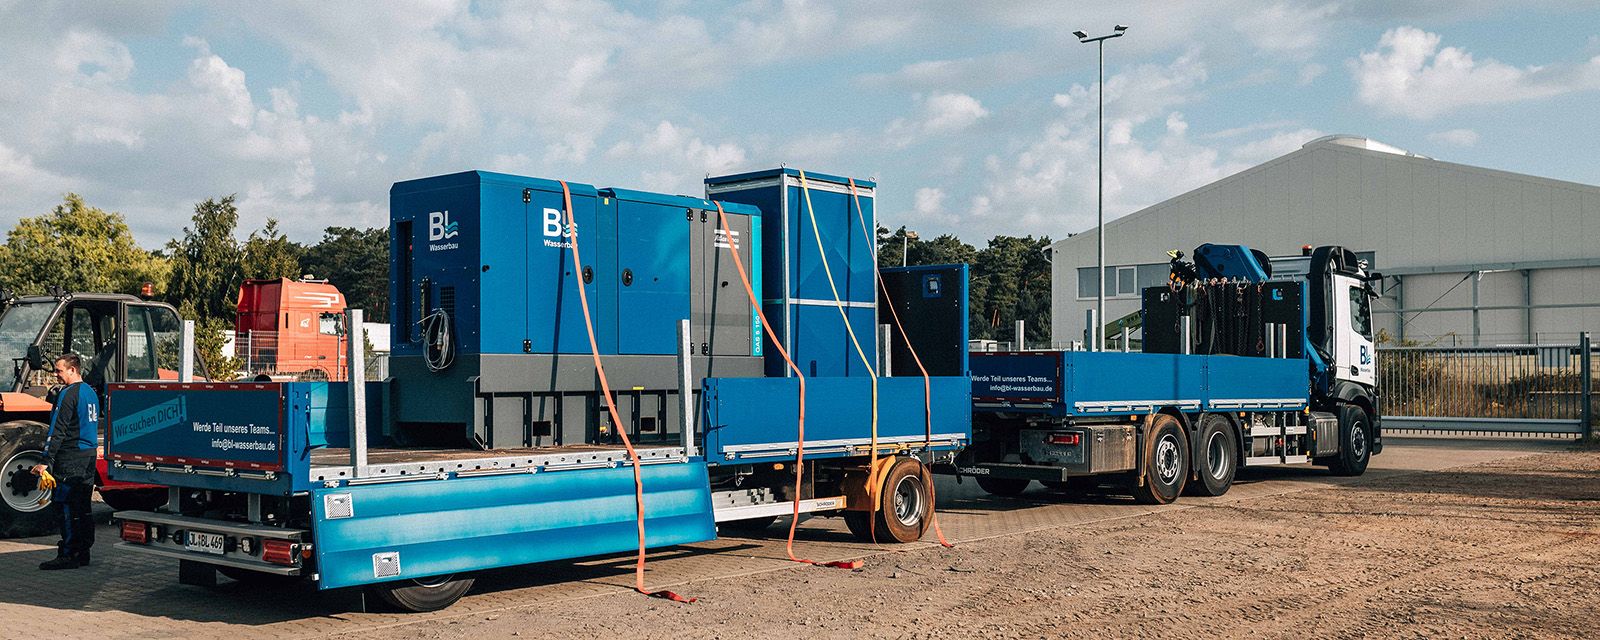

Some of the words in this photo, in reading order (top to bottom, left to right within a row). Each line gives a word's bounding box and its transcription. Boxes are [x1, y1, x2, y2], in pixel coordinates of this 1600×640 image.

[429, 242, 459, 251] Wasserbau
[543, 239, 578, 249] Wasserba
[1028, 375, 1052, 383] Teams...
[114, 423, 128, 439] Wir
[129, 415, 156, 433] suchen
[192, 421, 212, 432] Werde
[212, 422, 223, 433] Teil
[224, 424, 248, 434] unseres
[249, 423, 276, 435] Teams...
[211, 438, 276, 451] info@bl-wasserbau.de
[959, 465, 990, 475] CHRÖDER
[201, 534, 210, 548] BL
[211, 536, 223, 549] 469
